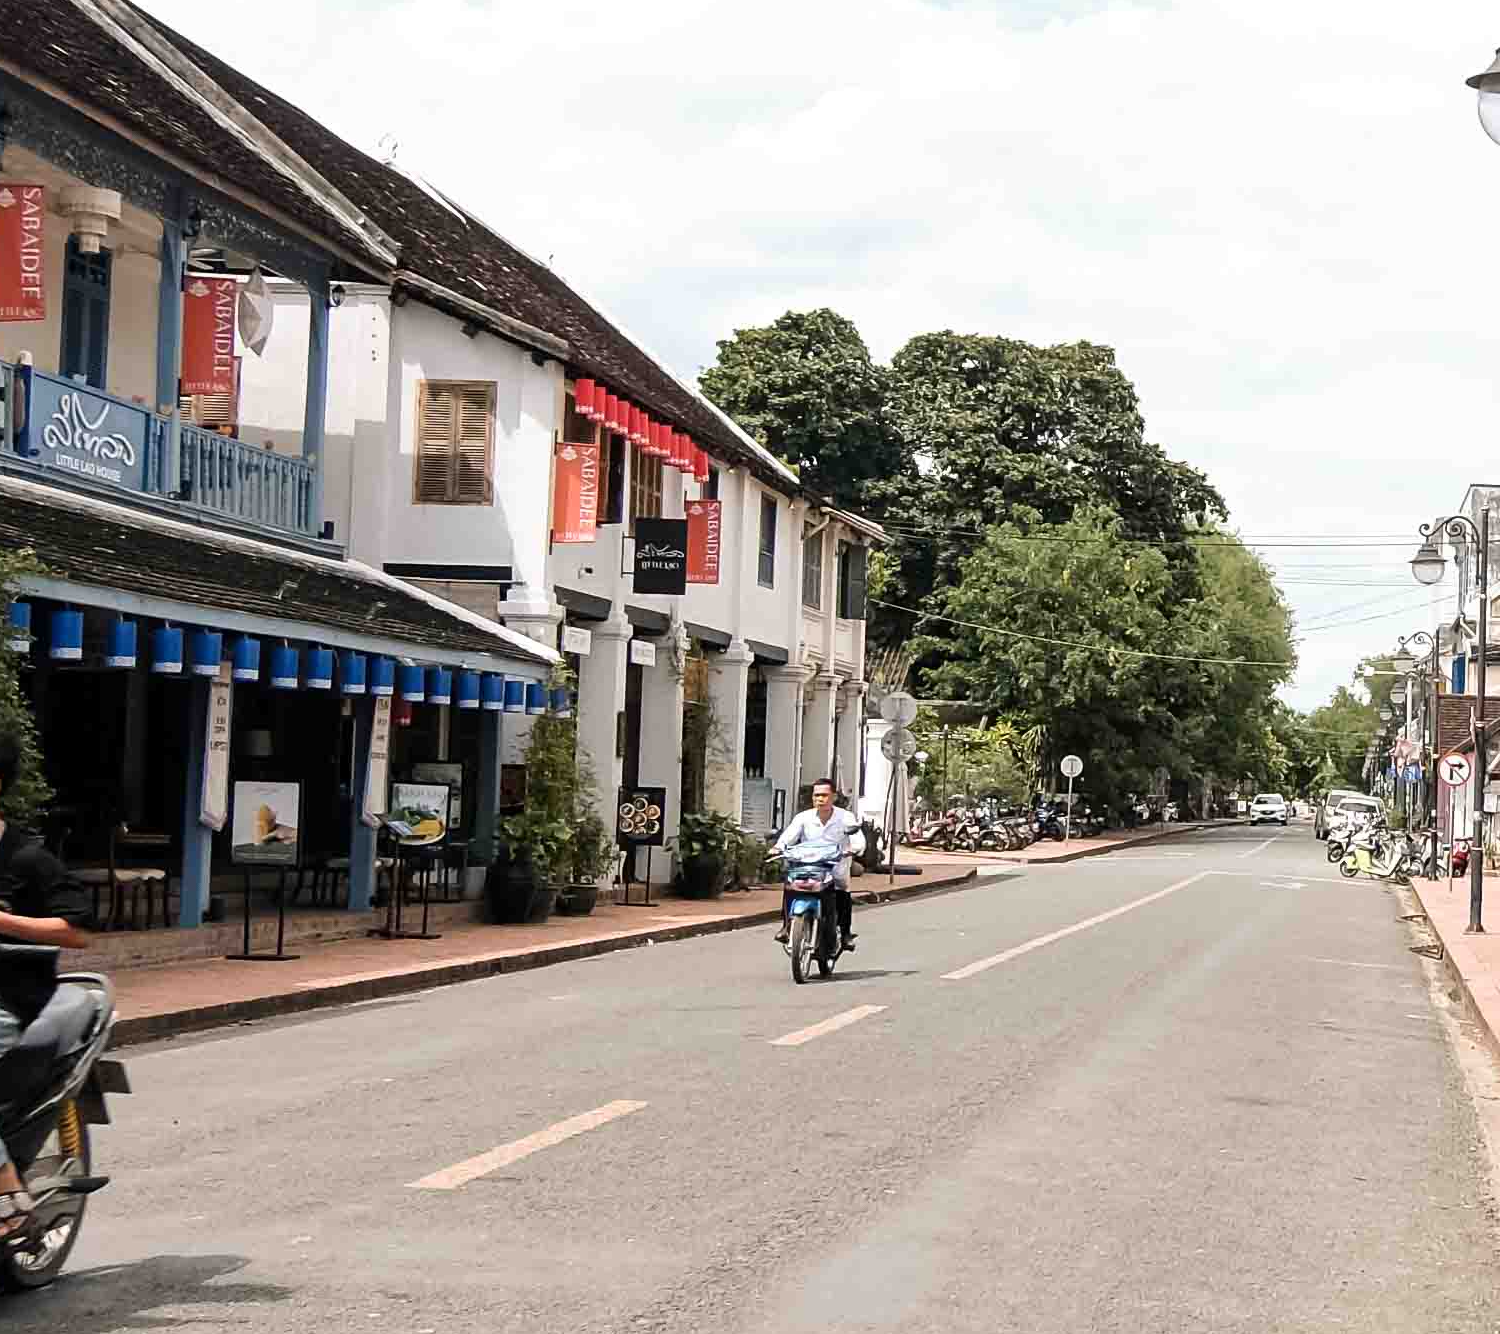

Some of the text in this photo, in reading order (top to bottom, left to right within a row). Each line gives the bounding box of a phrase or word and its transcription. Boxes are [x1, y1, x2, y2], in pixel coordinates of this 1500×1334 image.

[20, 187, 42, 299] SABAIDEE
[213, 280, 233, 378] SABAIDEE
[579, 447, 598, 528] SABAIDEE
[705, 502, 719, 571] SABAIDEE
